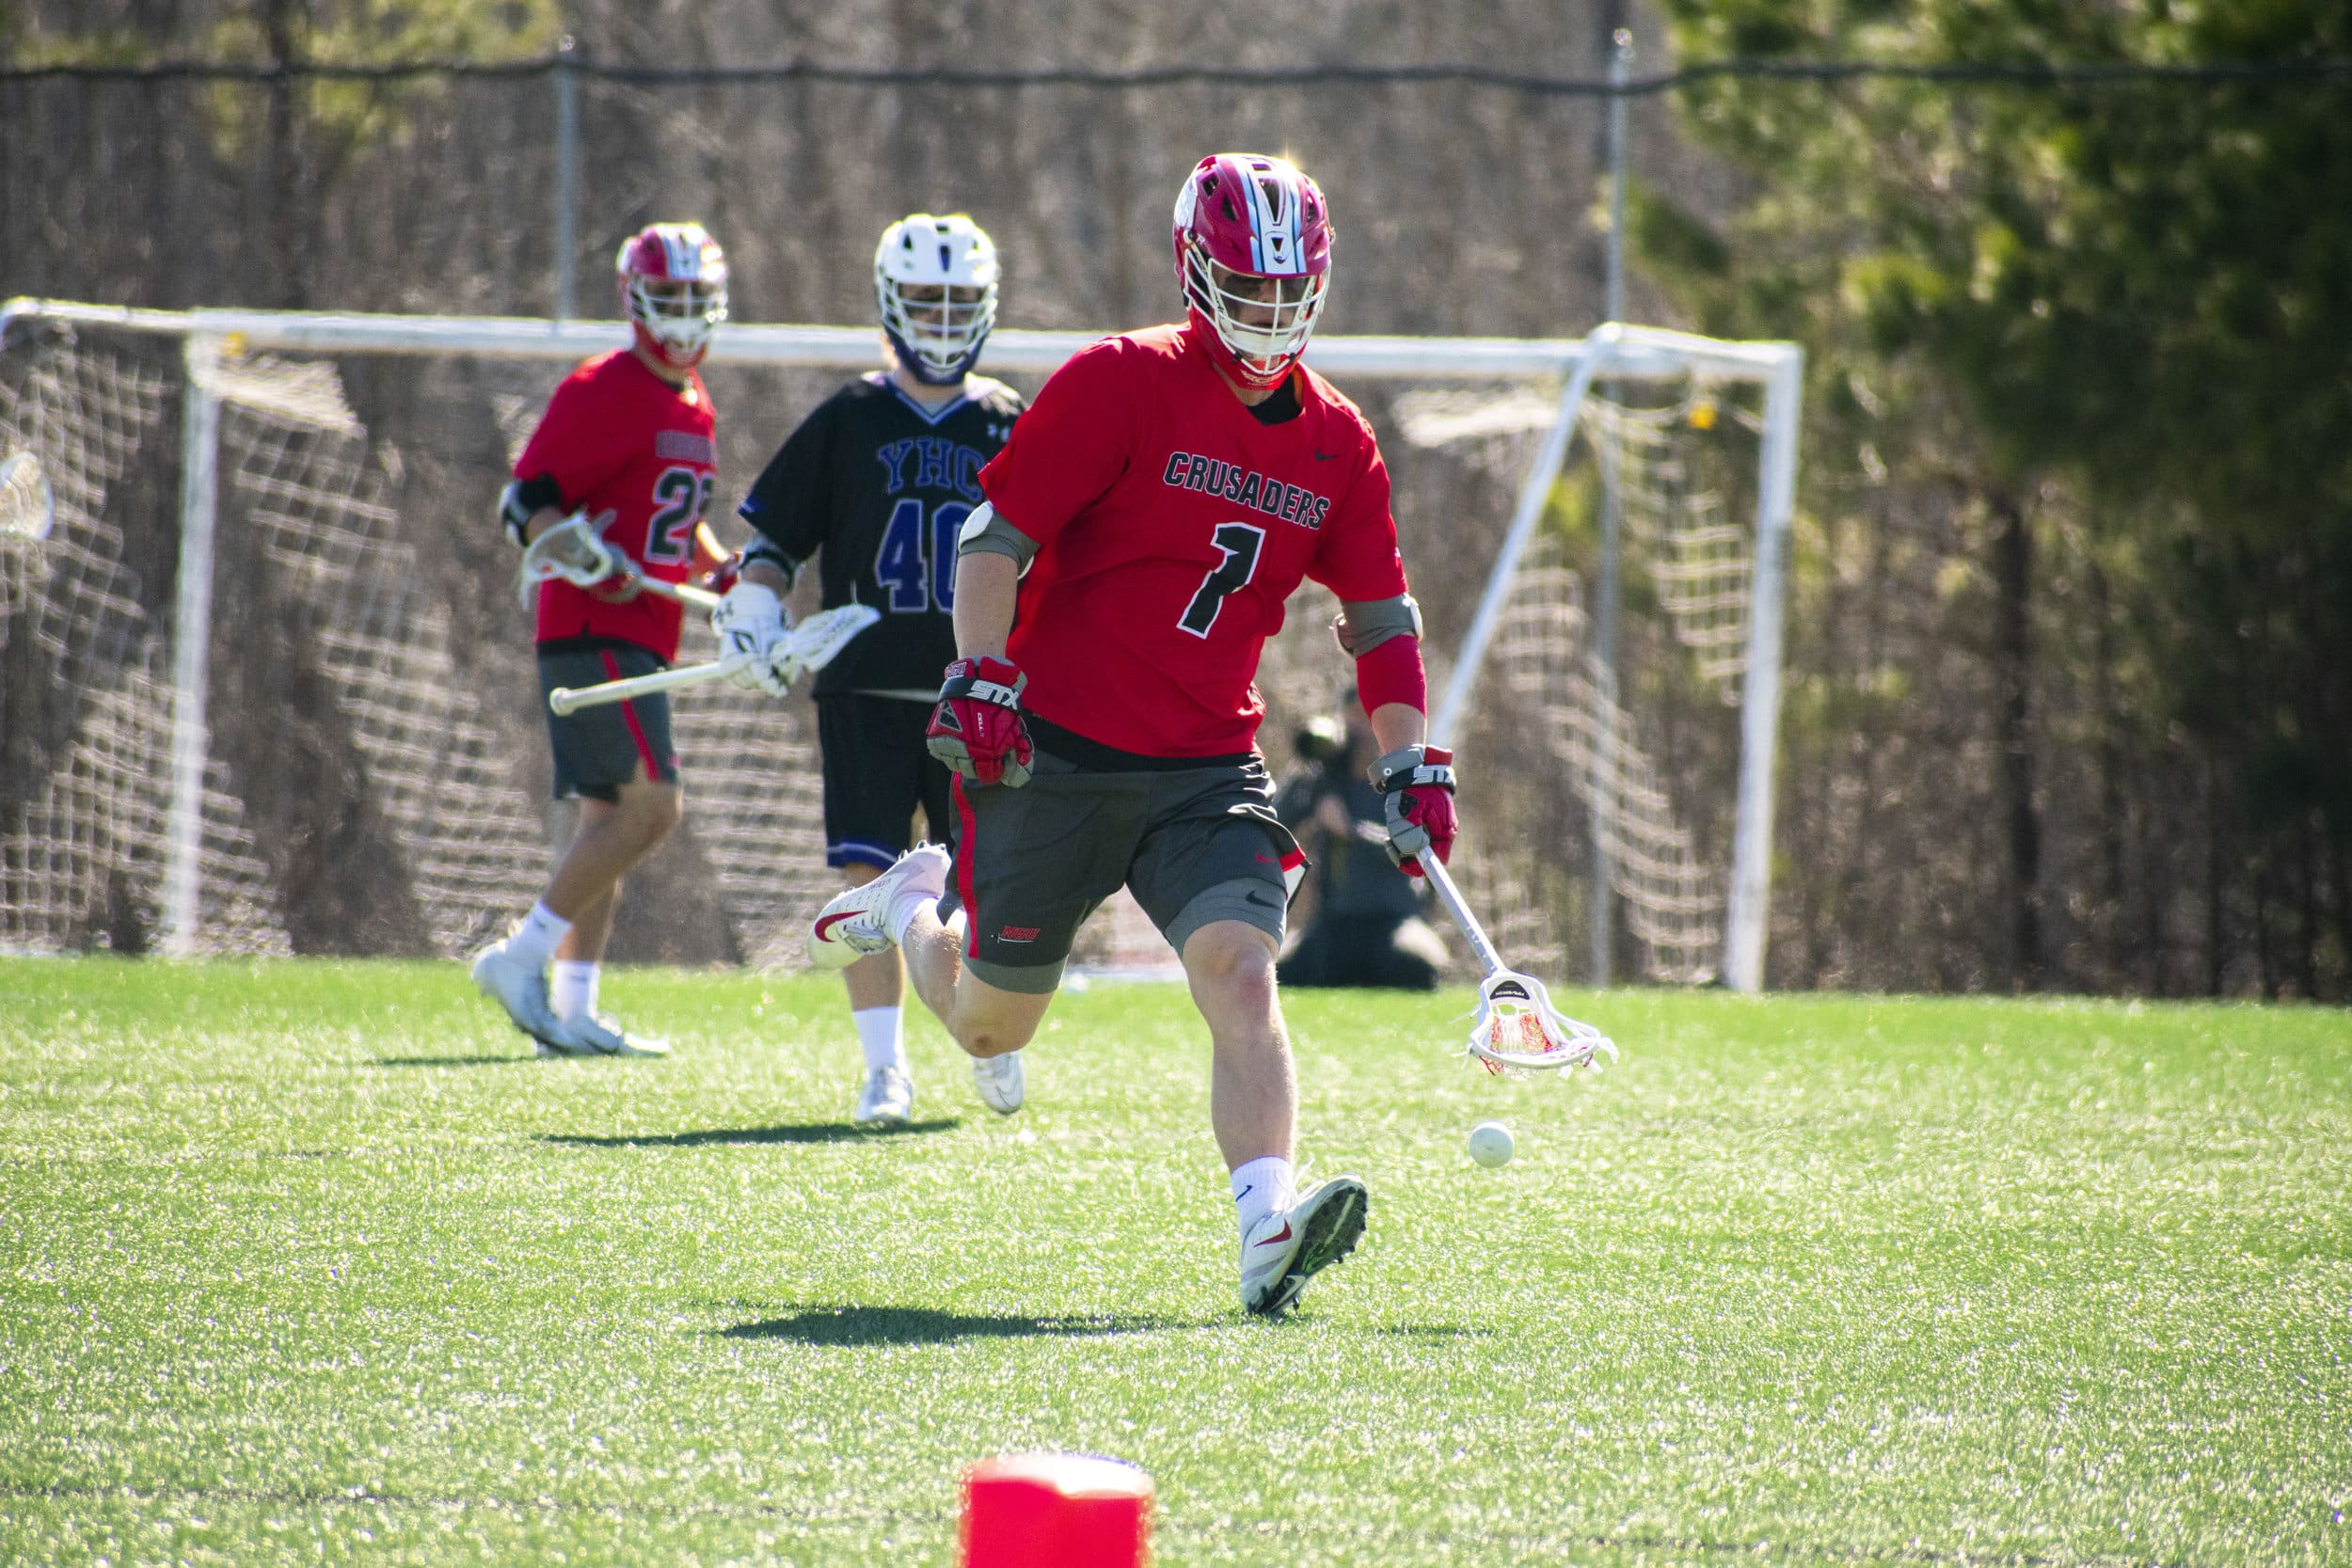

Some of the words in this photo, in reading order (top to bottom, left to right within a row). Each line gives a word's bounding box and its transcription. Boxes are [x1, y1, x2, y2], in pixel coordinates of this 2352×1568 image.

[878, 436, 985, 503] YHC
[1163, 451, 1331, 531] CRUSADERS
[966, 679, 1020, 710] STX
